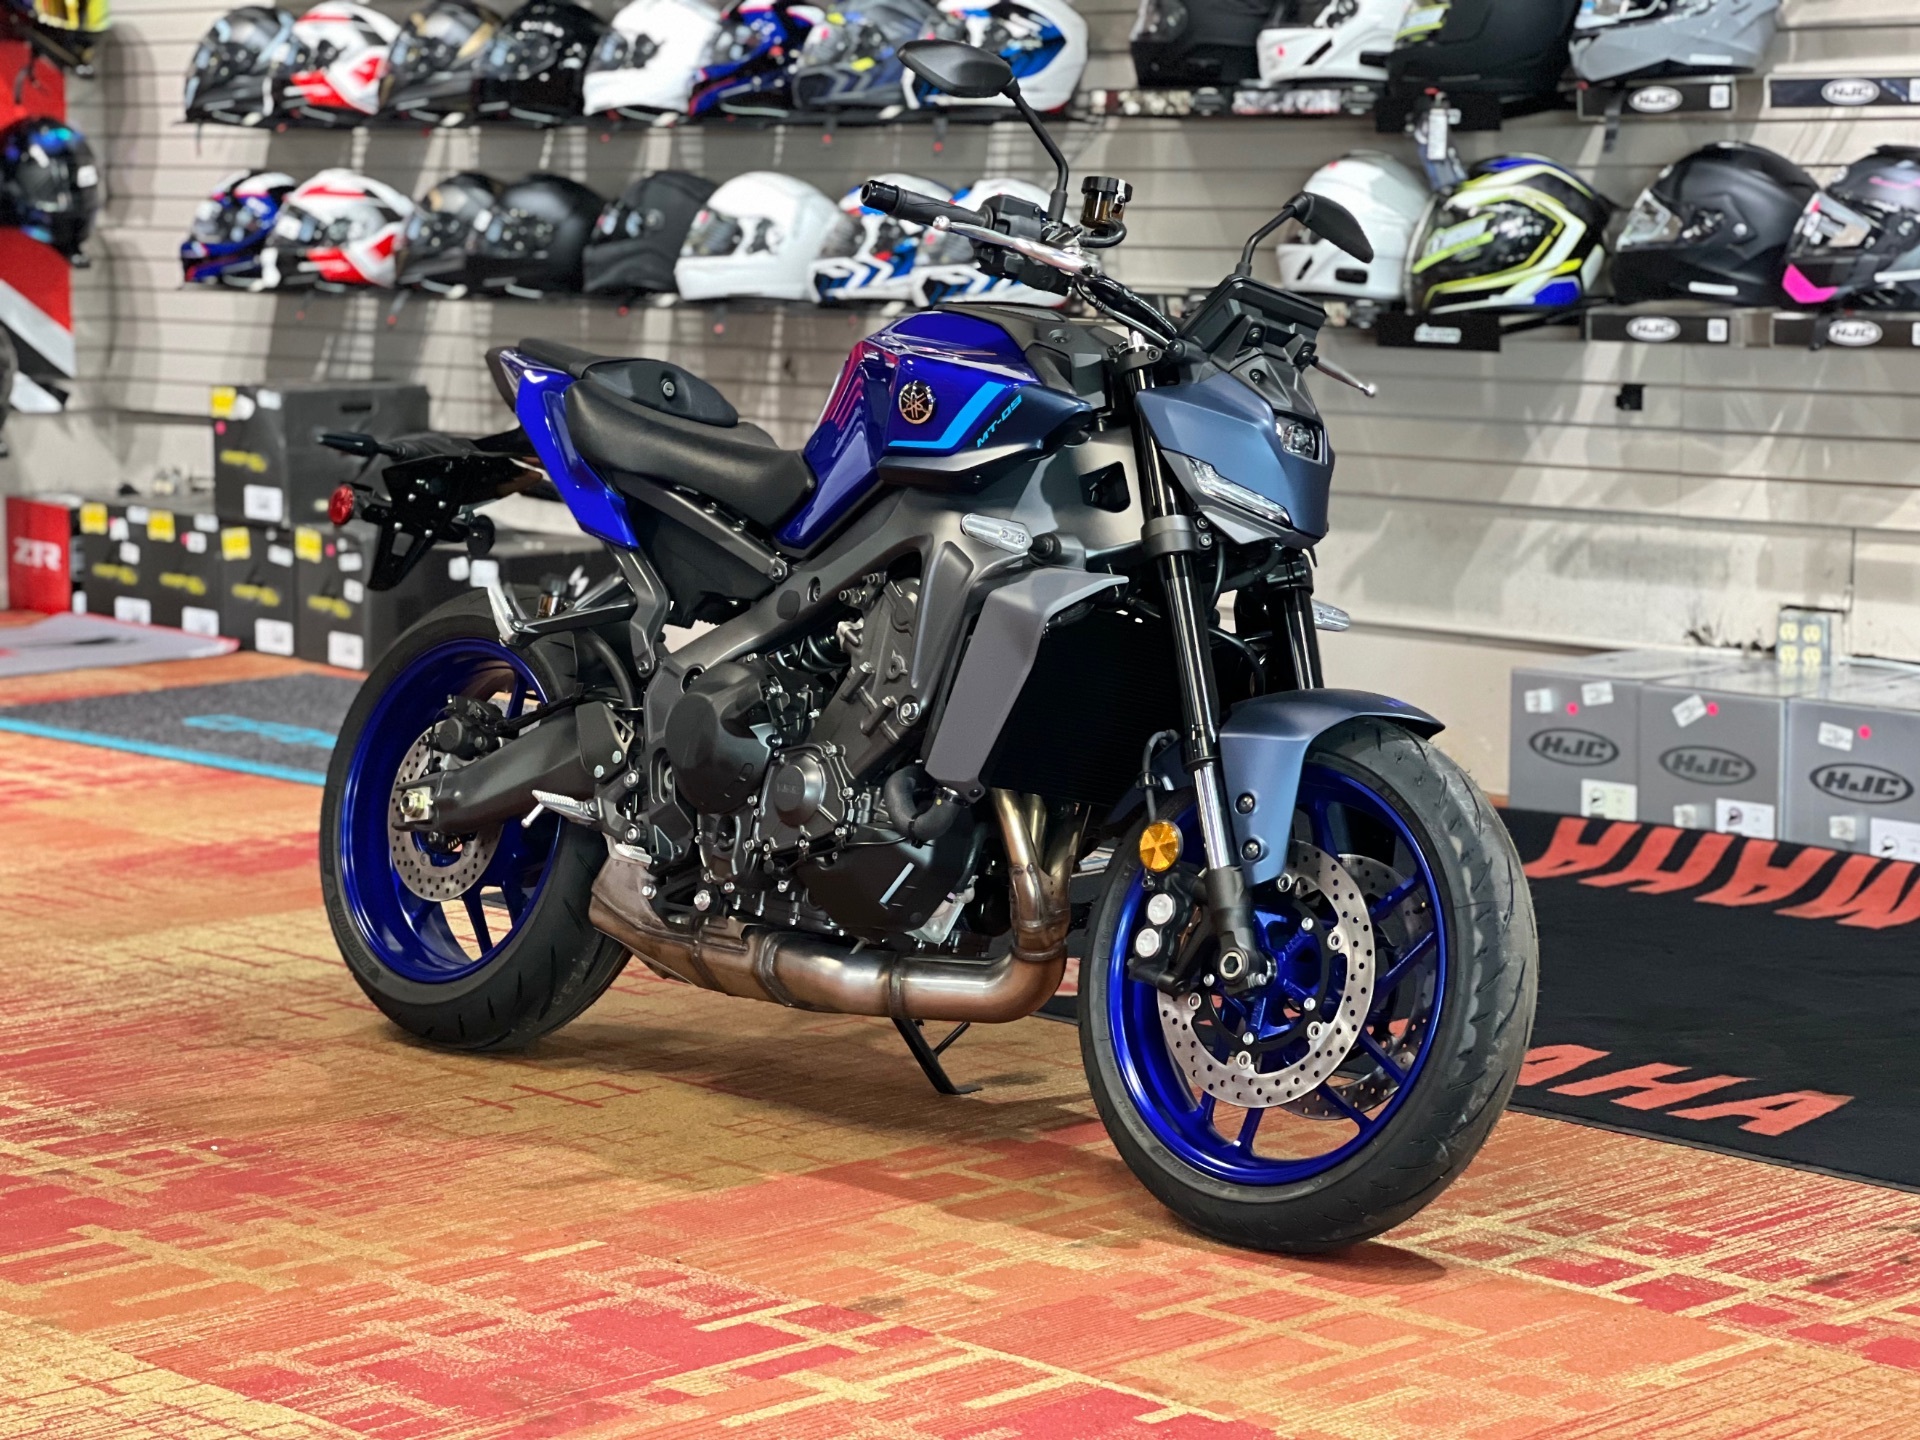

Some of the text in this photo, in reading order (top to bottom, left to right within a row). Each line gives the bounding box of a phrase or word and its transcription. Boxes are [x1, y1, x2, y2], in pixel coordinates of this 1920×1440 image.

[976, 394, 1022, 448] MT-09
[1542, 736, 1606, 759] HJC
[1672, 753, 1742, 777] HJC
[1823, 770, 1900, 796] HJC
